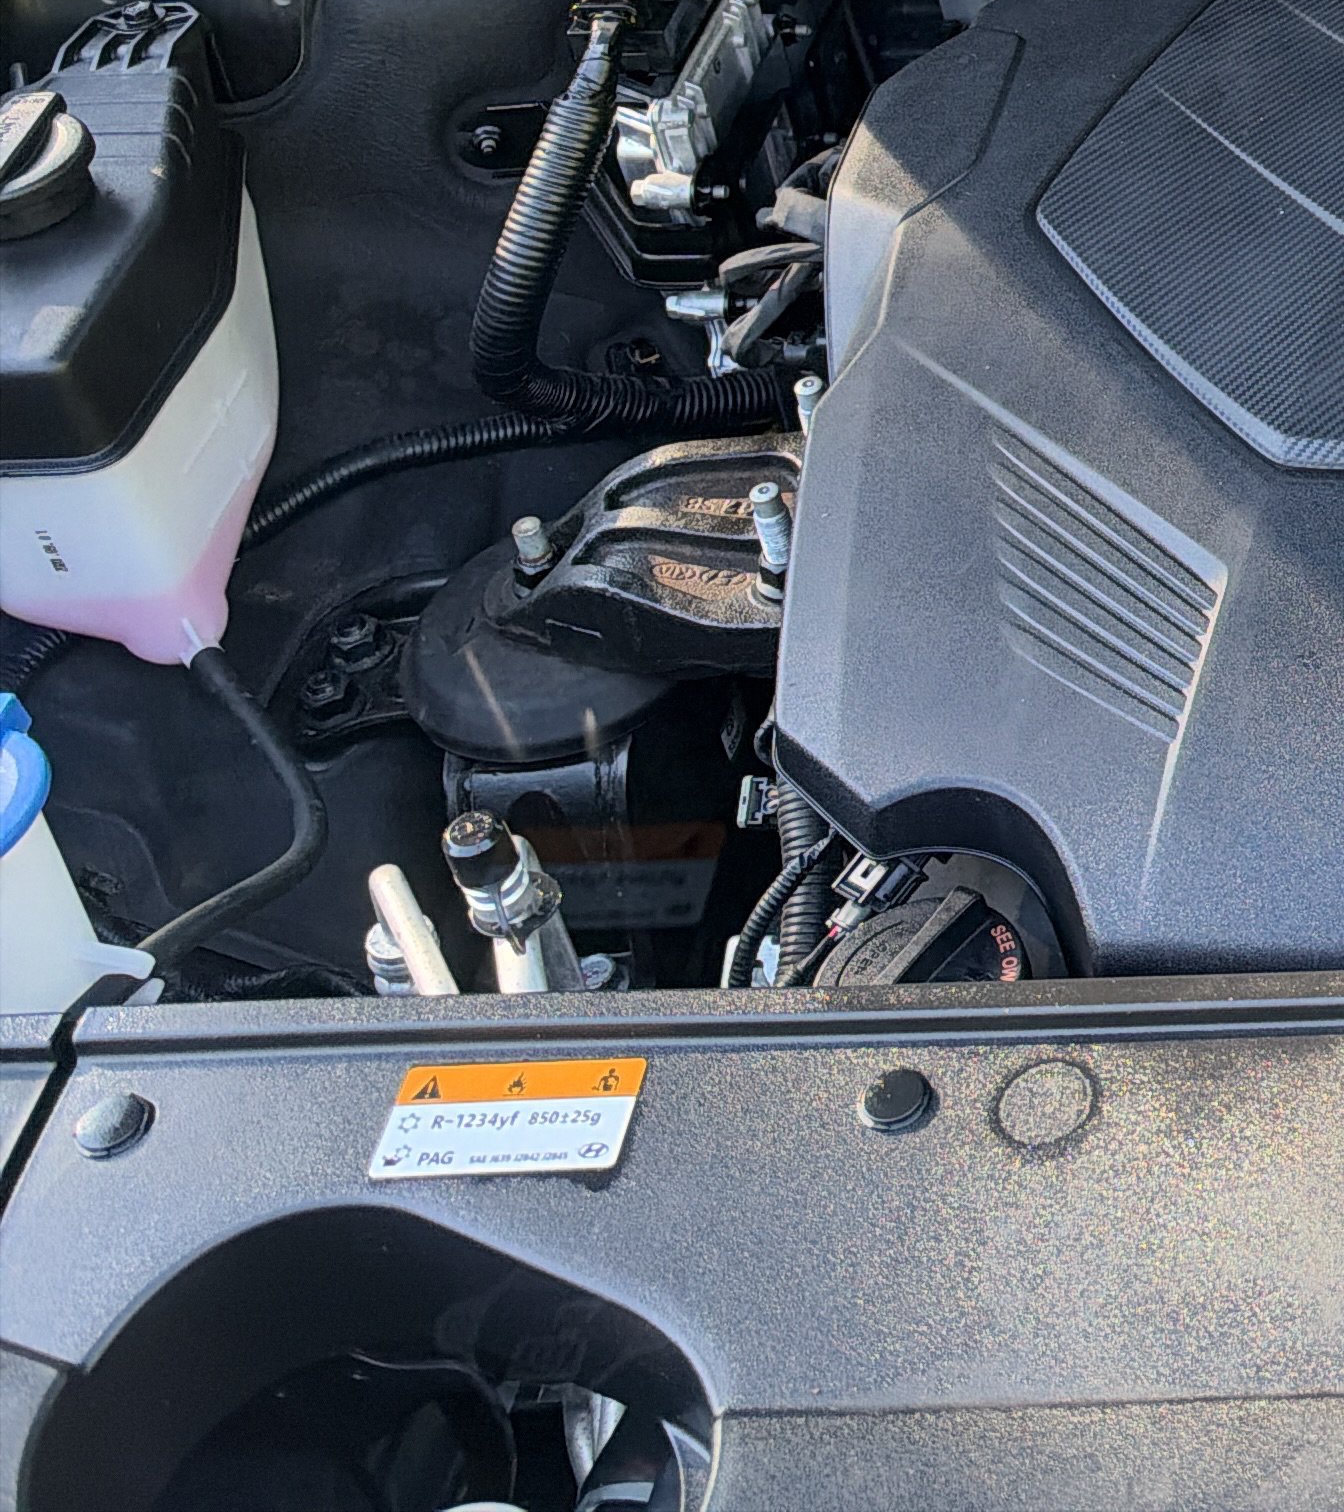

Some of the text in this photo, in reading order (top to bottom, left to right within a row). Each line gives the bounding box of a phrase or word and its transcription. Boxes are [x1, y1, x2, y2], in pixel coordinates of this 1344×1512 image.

[990, 924, 1016, 954] SEE
[431, 1109, 602, 1131] R-1234yf 850±25g
[417, 1150, 455, 1167] PAG
